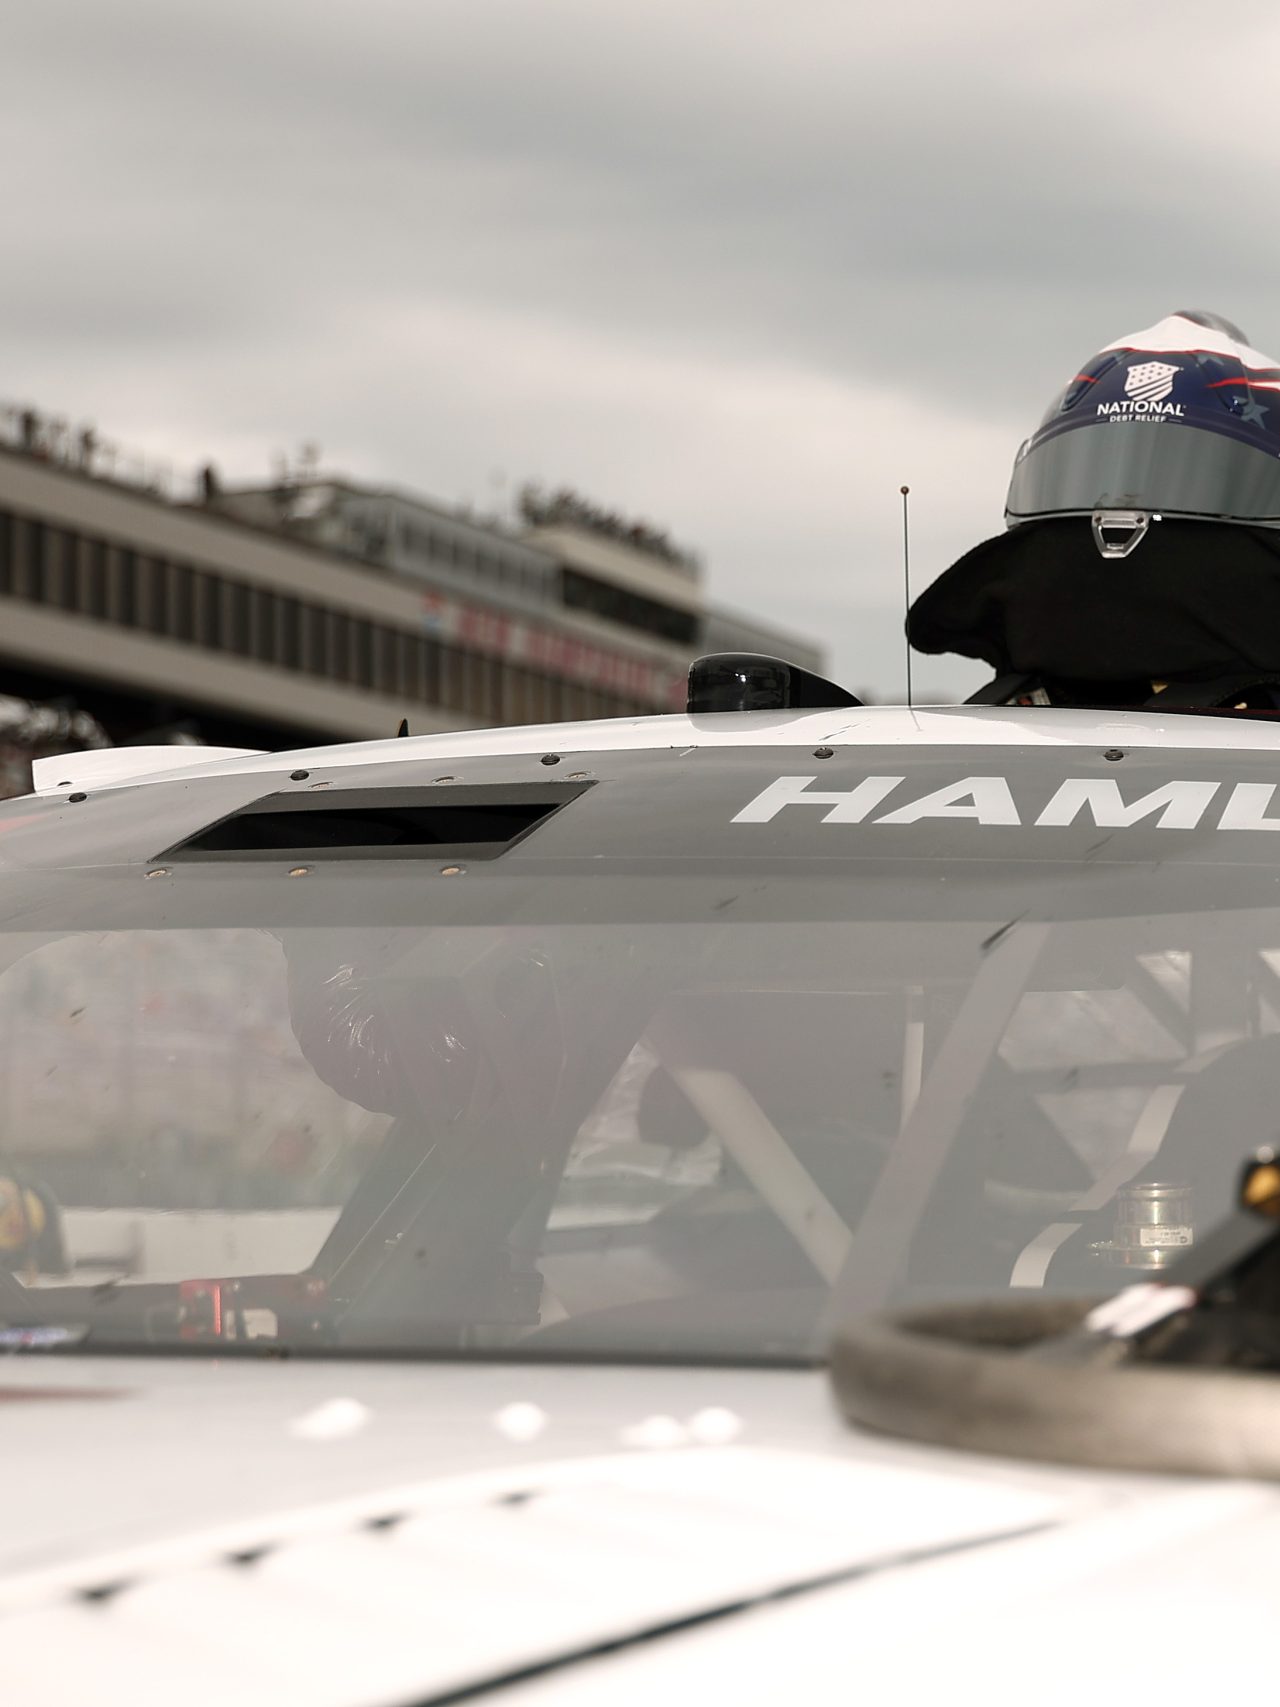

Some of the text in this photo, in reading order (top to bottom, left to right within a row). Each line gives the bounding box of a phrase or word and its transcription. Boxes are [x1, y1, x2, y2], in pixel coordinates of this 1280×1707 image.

[1097, 401, 1184, 417] NATIONAL
[1109, 414, 1167, 423] DEBT RELIEF
